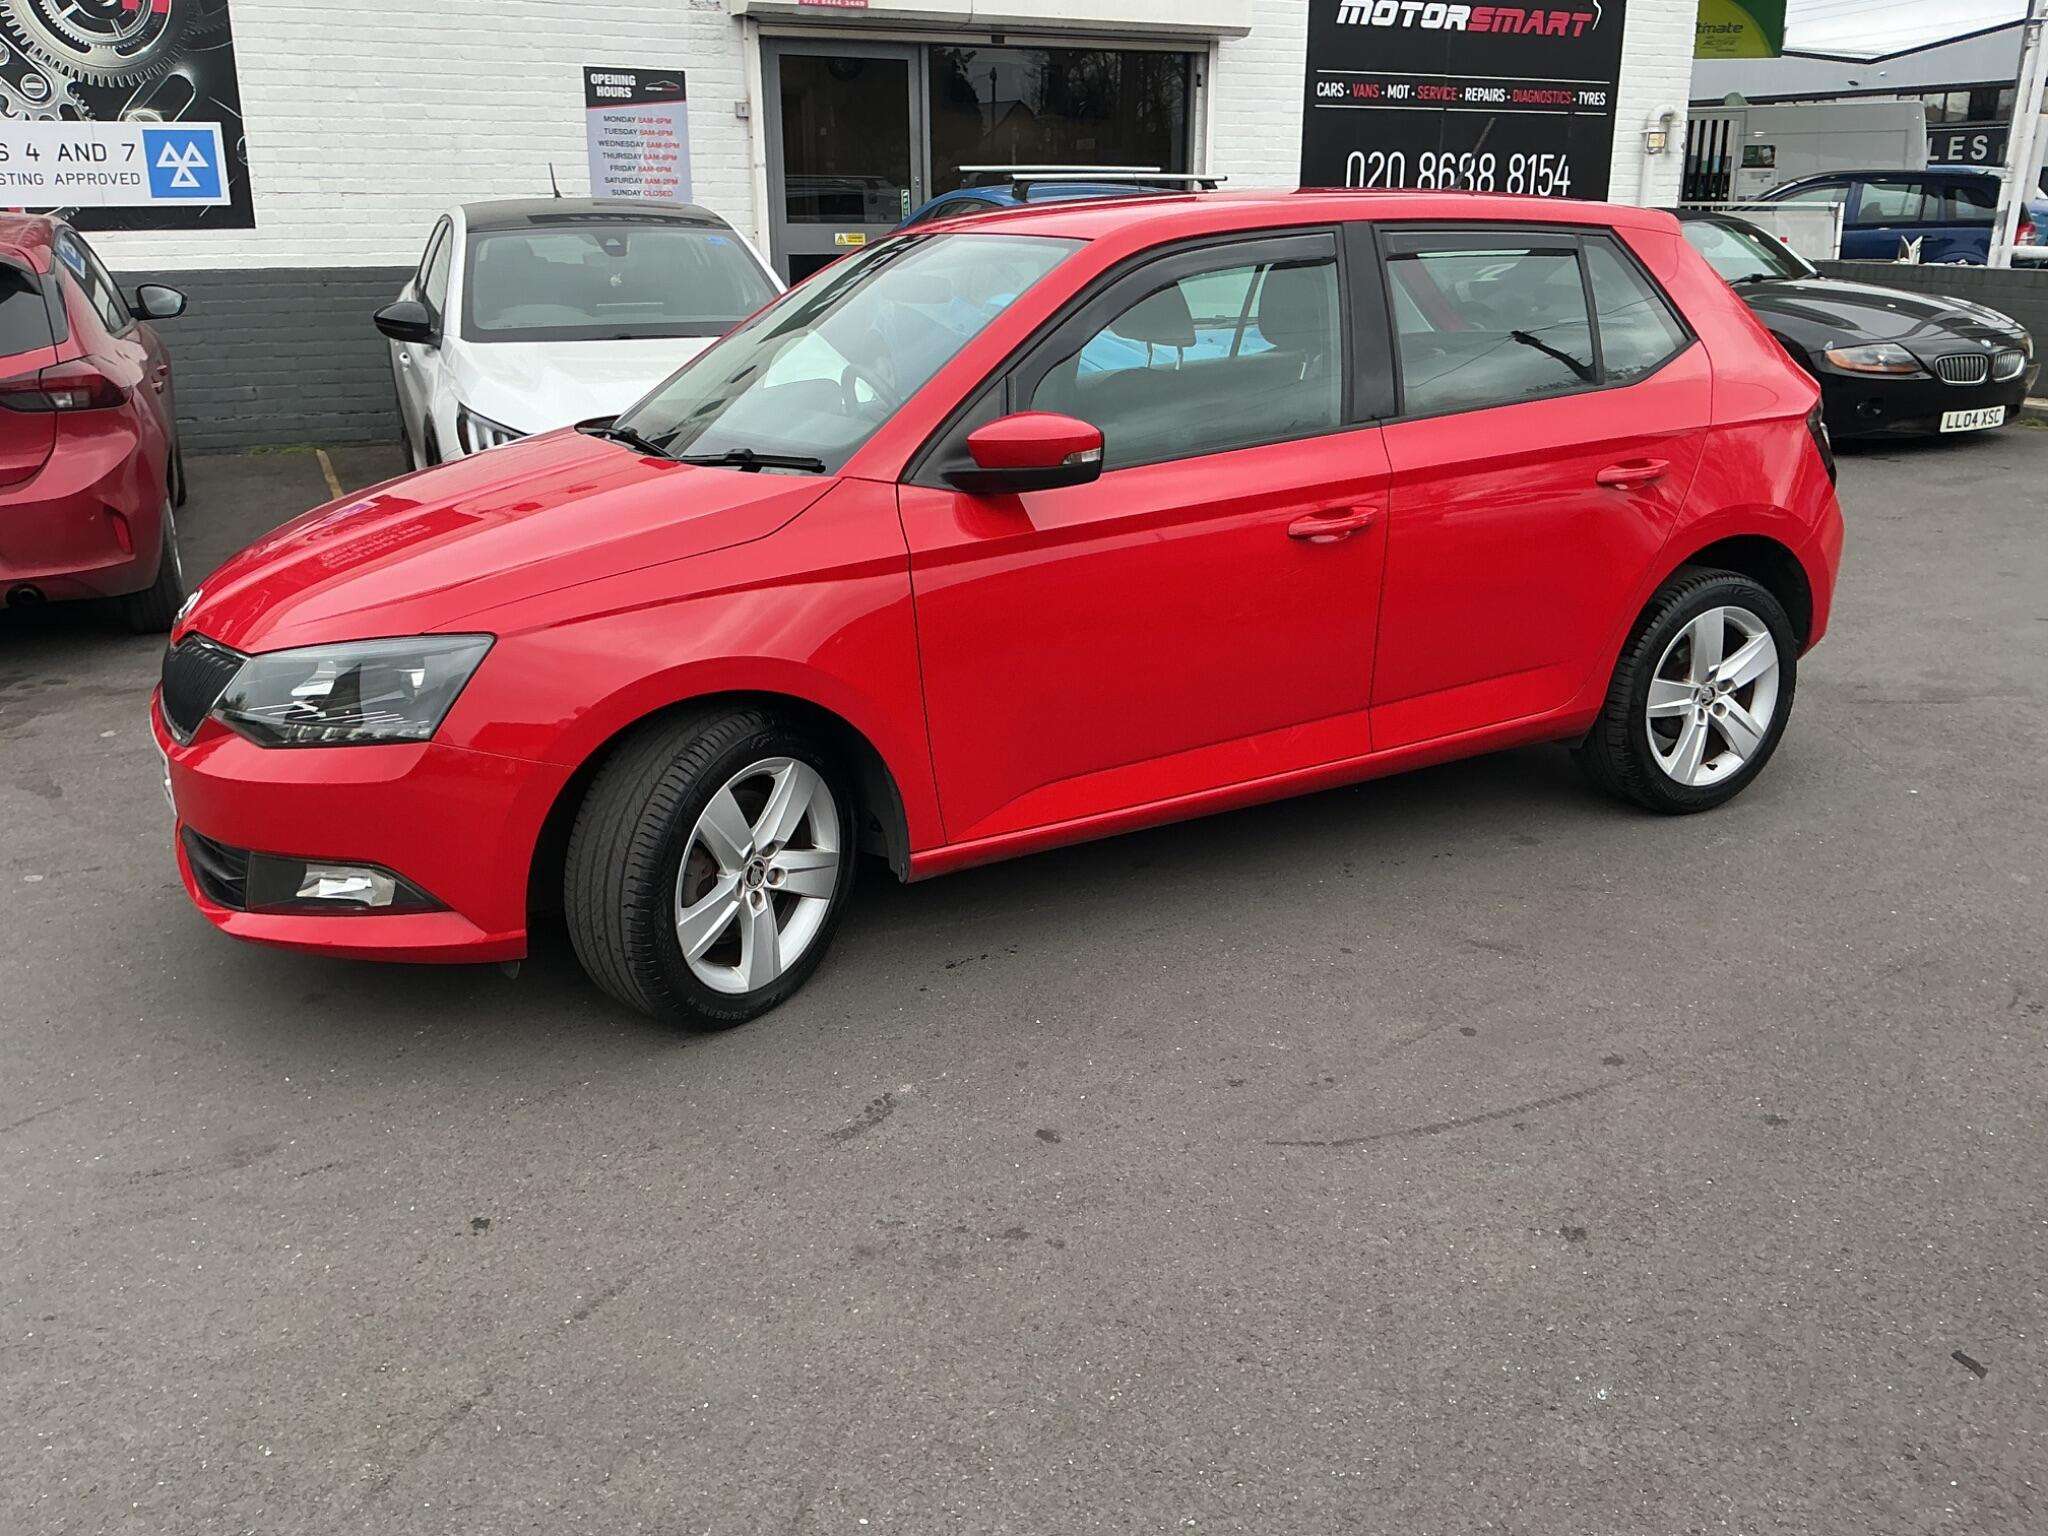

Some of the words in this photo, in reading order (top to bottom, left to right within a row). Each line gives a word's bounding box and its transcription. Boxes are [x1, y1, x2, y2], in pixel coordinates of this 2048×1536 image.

[1336, 0, 1593, 37] MOTORSMART
[590, 73, 636, 86] OPENING
[596, 86, 633, 98] HOURS
[1316, 82, 1345, 97] CARS
[1352, 83, 1380, 98] VANS
[1387, 84, 1410, 99] MOT
[1417, 85, 1457, 101] SERVICE
[1465, 87, 1506, 102] REPAIRS
[1512, 89, 1572, 104] DIAGNOSTICS
[1578, 91, 1606, 106] TYRES
[603, 115, 636, 123] MONDAY
[598, 140, 644, 148] WEDNESDAY
[25, 143, 40, 162] 4
[57, 143, 108, 162] AND
[121, 143, 136, 162] 7
[602, 152, 642, 160] THURSDAY
[54, 172, 141, 186] APPROVED
[1345, 151, 1406, 189] 020
[1416, 151, 1497, 193] 8638
[1506, 153, 1571, 197] 8154
[611, 189, 641, 197] SUNDAY
[643, 189, 673, 197] CLOSED
[1946, 412, 1979, 429] LL04
[1980, 408, 2002, 426] XSC
